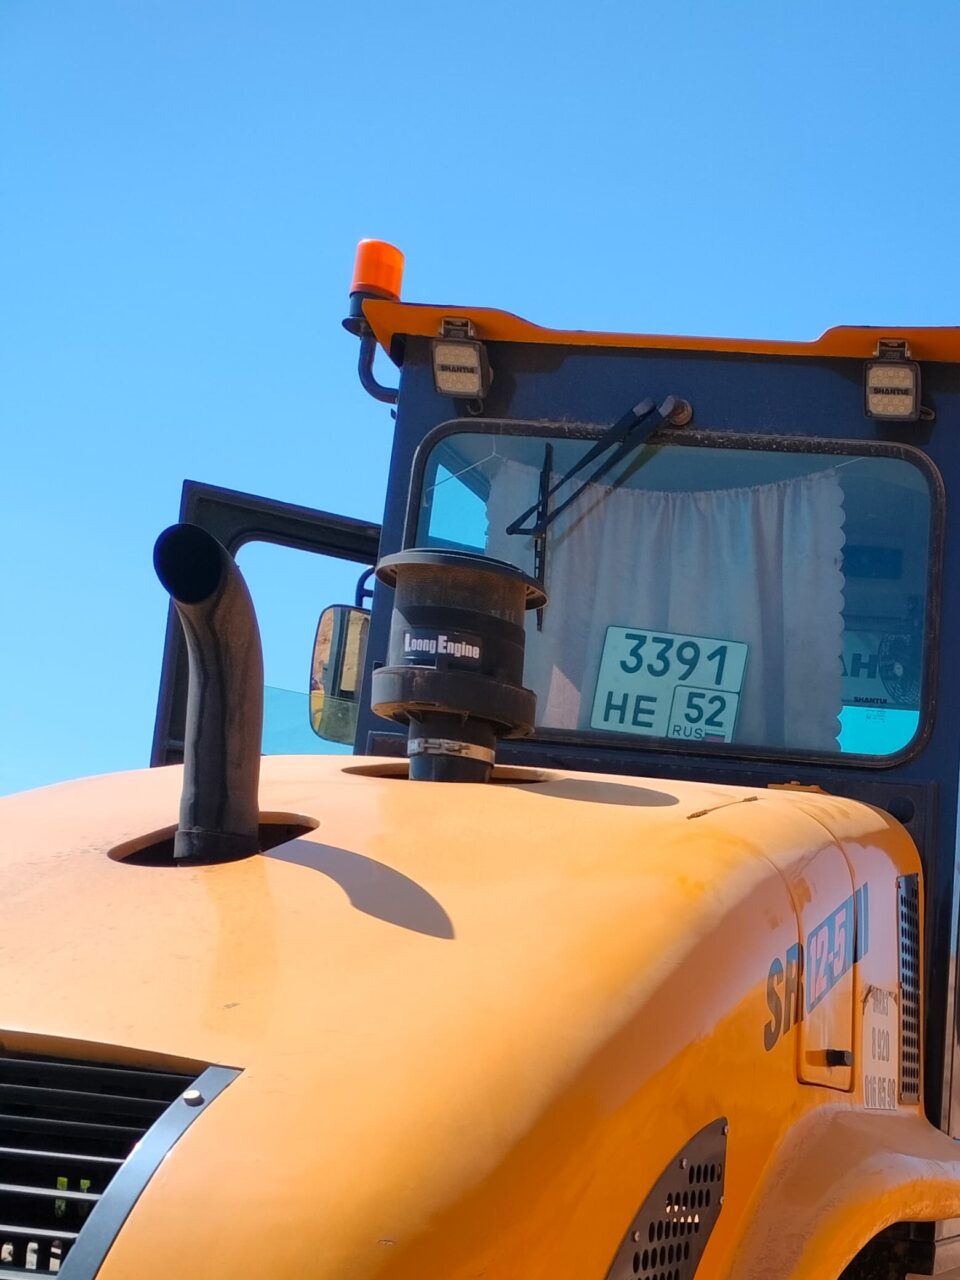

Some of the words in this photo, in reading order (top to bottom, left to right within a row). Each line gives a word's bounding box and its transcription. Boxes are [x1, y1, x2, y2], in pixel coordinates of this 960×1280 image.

[620, 633, 728, 685] 3391
[603, 691, 657, 728] HE
[684, 692, 726, 728] 52
[853, 696, 888, 704] SHANTUI
[672, 725, 704, 738] RUS
[764, 942, 804, 1052] SR
[809, 908, 847, 1005] 12-5
[877, 1028, 890, 1062] 920
